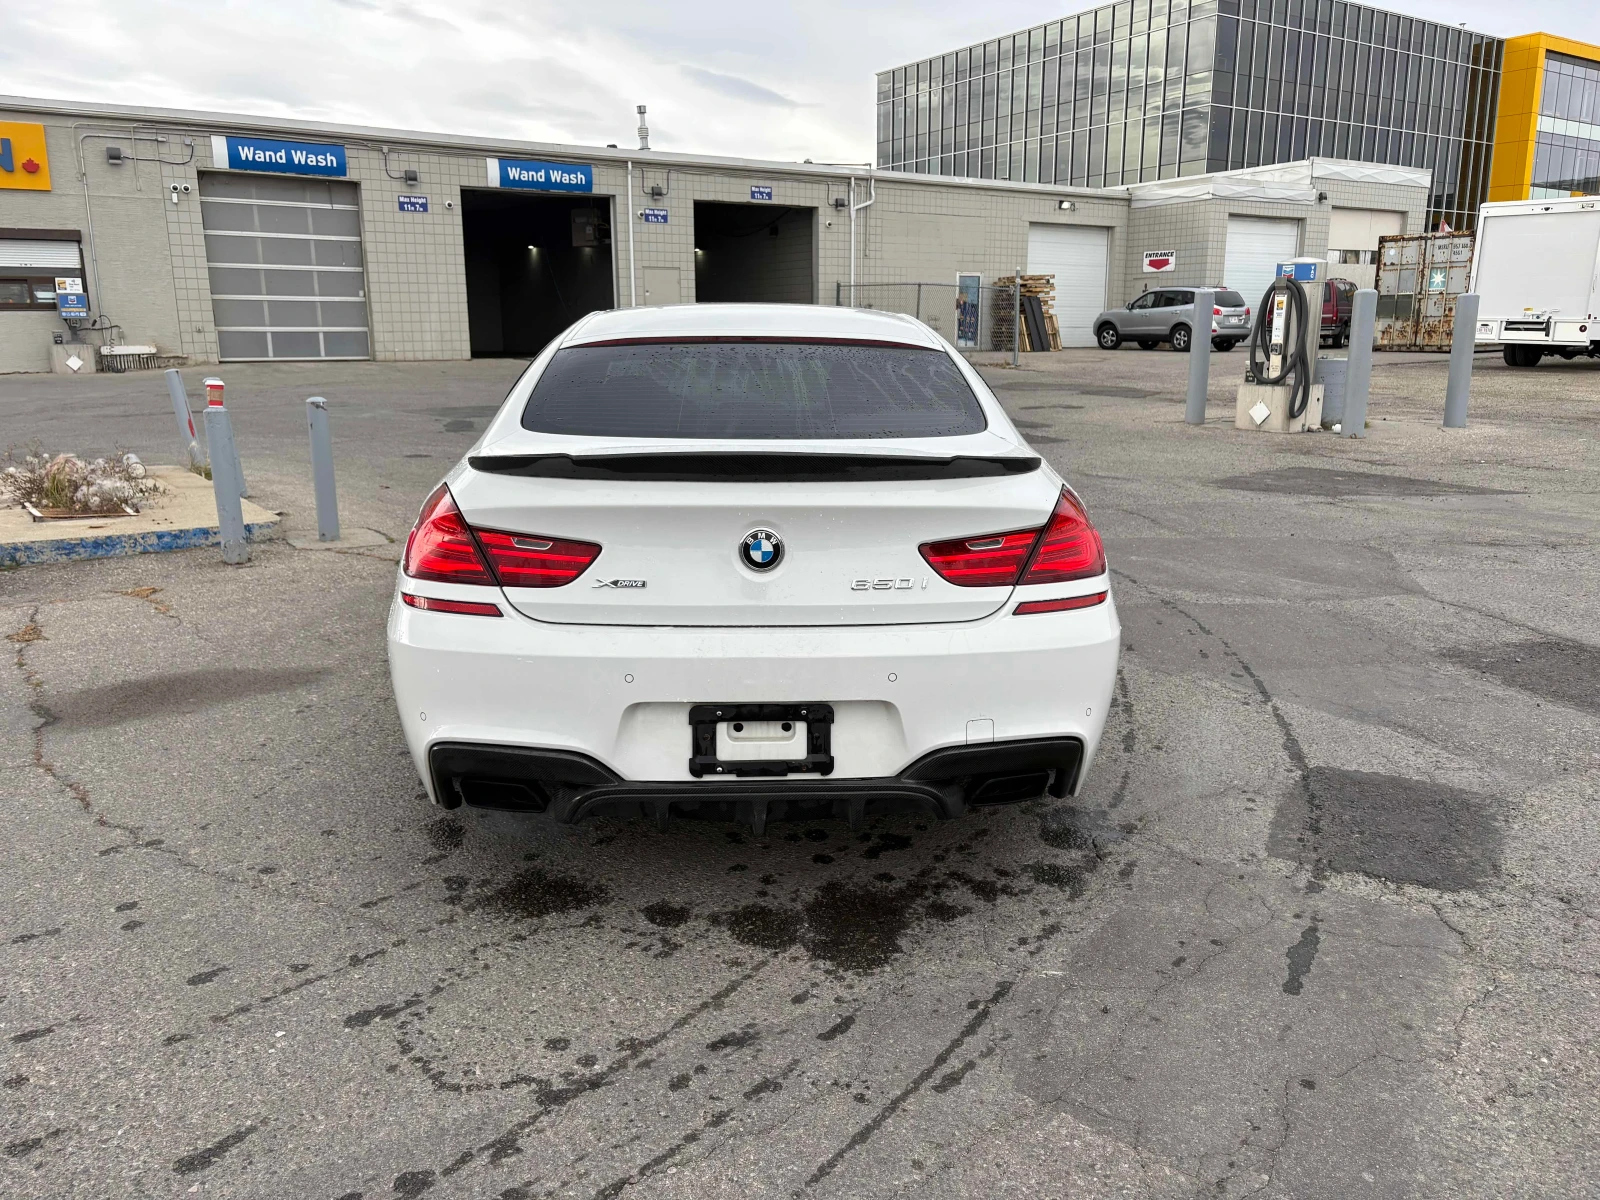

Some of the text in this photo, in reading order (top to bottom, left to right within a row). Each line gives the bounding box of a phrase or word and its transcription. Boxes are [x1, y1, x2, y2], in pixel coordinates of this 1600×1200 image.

[238, 145, 337, 168] Wand Wash
[507, 166, 586, 185] Wand Wash
